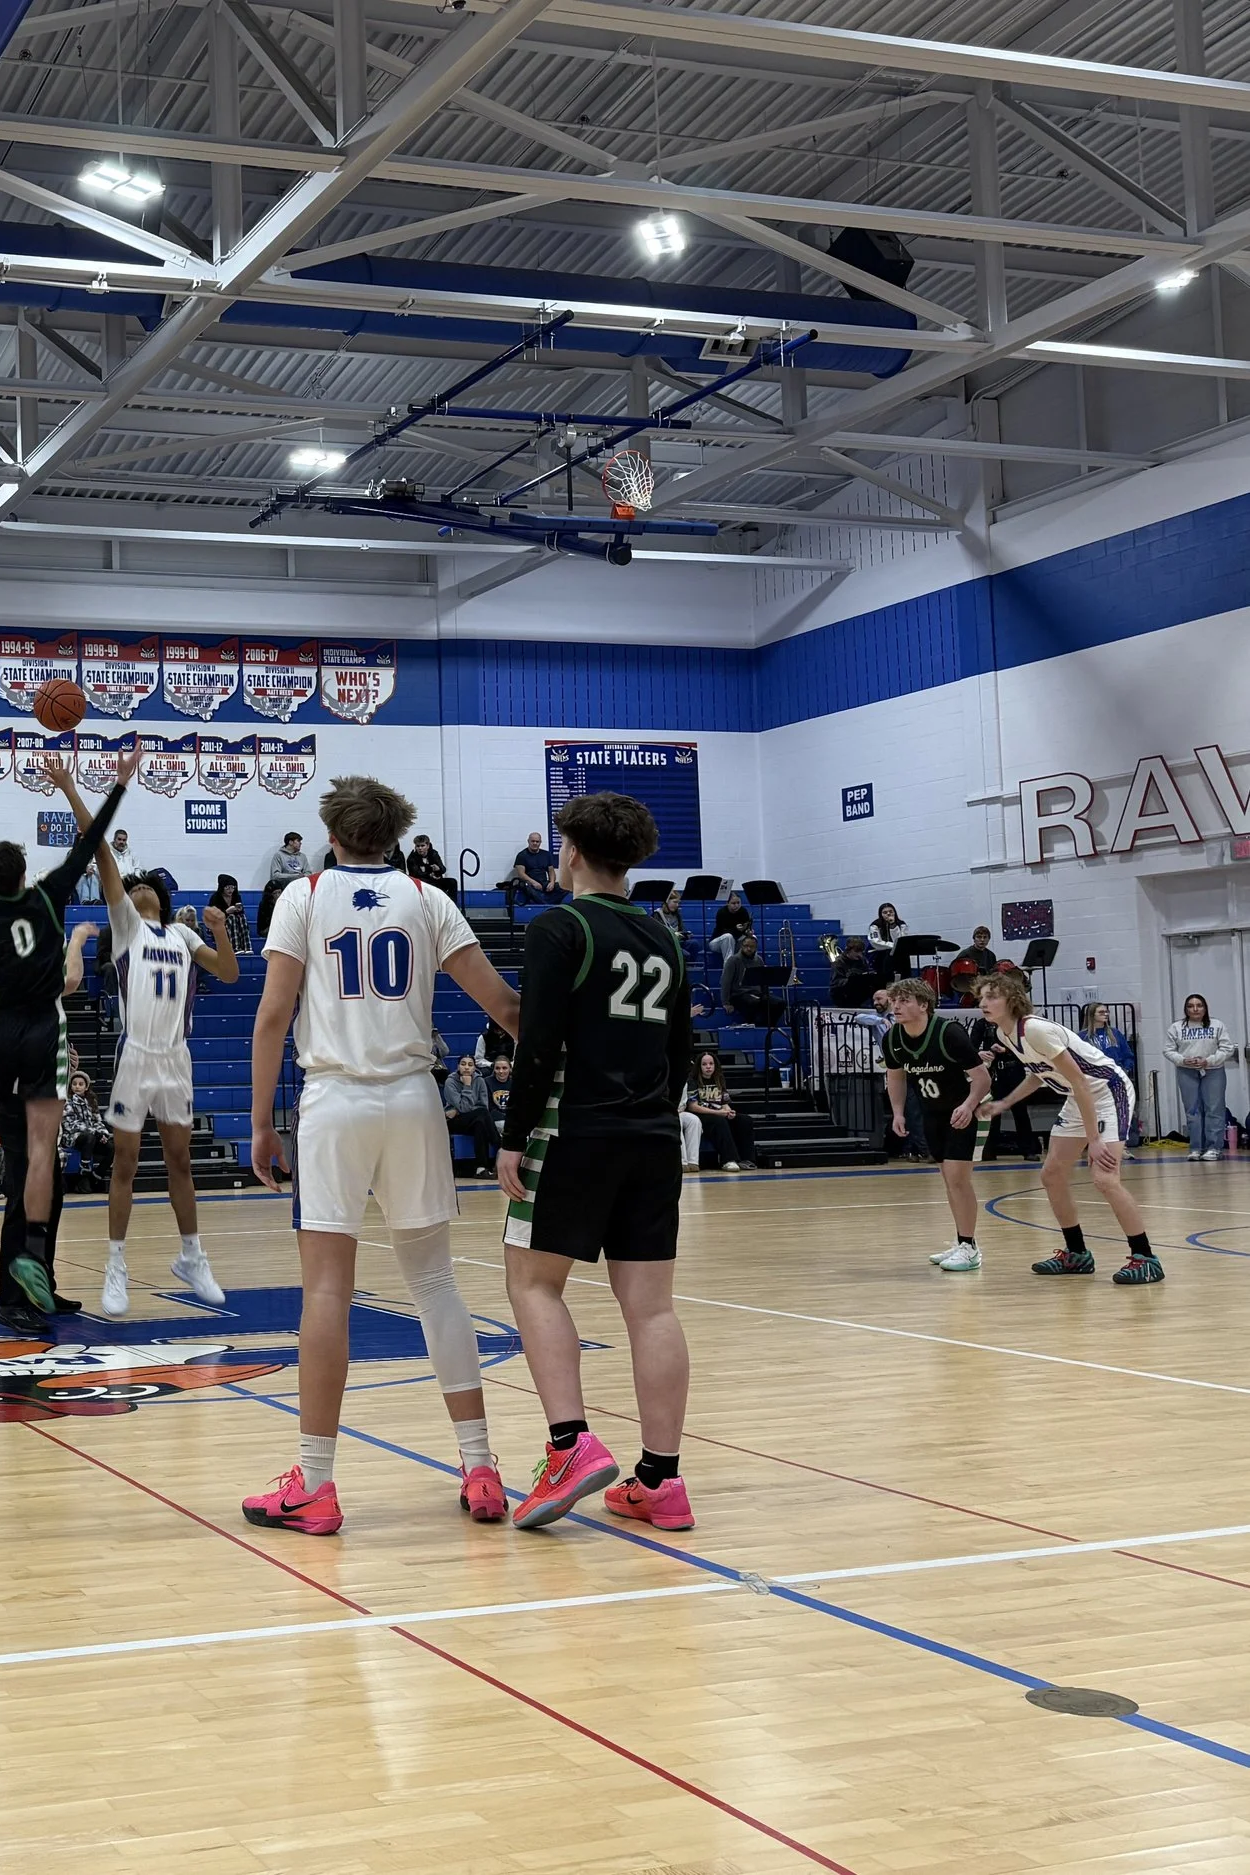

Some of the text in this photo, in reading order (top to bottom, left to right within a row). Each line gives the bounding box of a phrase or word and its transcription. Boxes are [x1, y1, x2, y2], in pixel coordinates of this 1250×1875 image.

[1, 641, 35, 654] 1994-95
[85, 644, 118, 657] 1998-99
[166, 646, 199, 659] 1999-00
[246, 649, 278, 661] 2006-07
[22, 659, 47, 667] DIVISION
[186, 664, 210, 672] DIVISION
[3, 668, 72, 681] STATE CHAMPION
[87, 672, 154, 685] STATE CHAMPION
[168, 673, 234, 686] STATE CHAMPION
[336, 671, 380, 686] WHO'S
[248, 675, 312, 688] STATE CHAMPION
[338, 689, 379, 704] NEXT?
[88, 760, 117, 769] ALL-OH
[576, 751, 667, 765] STATE PLACERS
[150, 761, 185, 770] ALL-OHIO
[210, 762, 245, 772] ALL-OHIO
[269, 763, 305, 772] ALL-OHIO
[847, 788, 867, 802] PEP
[191, 804, 221, 815] HOME
[845, 802, 870, 818] BAND
[44, 812, 76, 824] RAVEN
[187, 819, 226, 830] STUDENTS
[51, 824, 73, 832] DO IT
[49, 833, 77, 845] BEST
[10, 918, 36, 958] 0
[325, 927, 413, 1001] 10
[152, 969, 176, 1002] 11
[609, 950, 672, 1024] 22
[1182, 1027, 1214, 1037] RAVENS
[903, 1062, 945, 1075] Mogadore
[918, 1078, 940, 1098] 10
